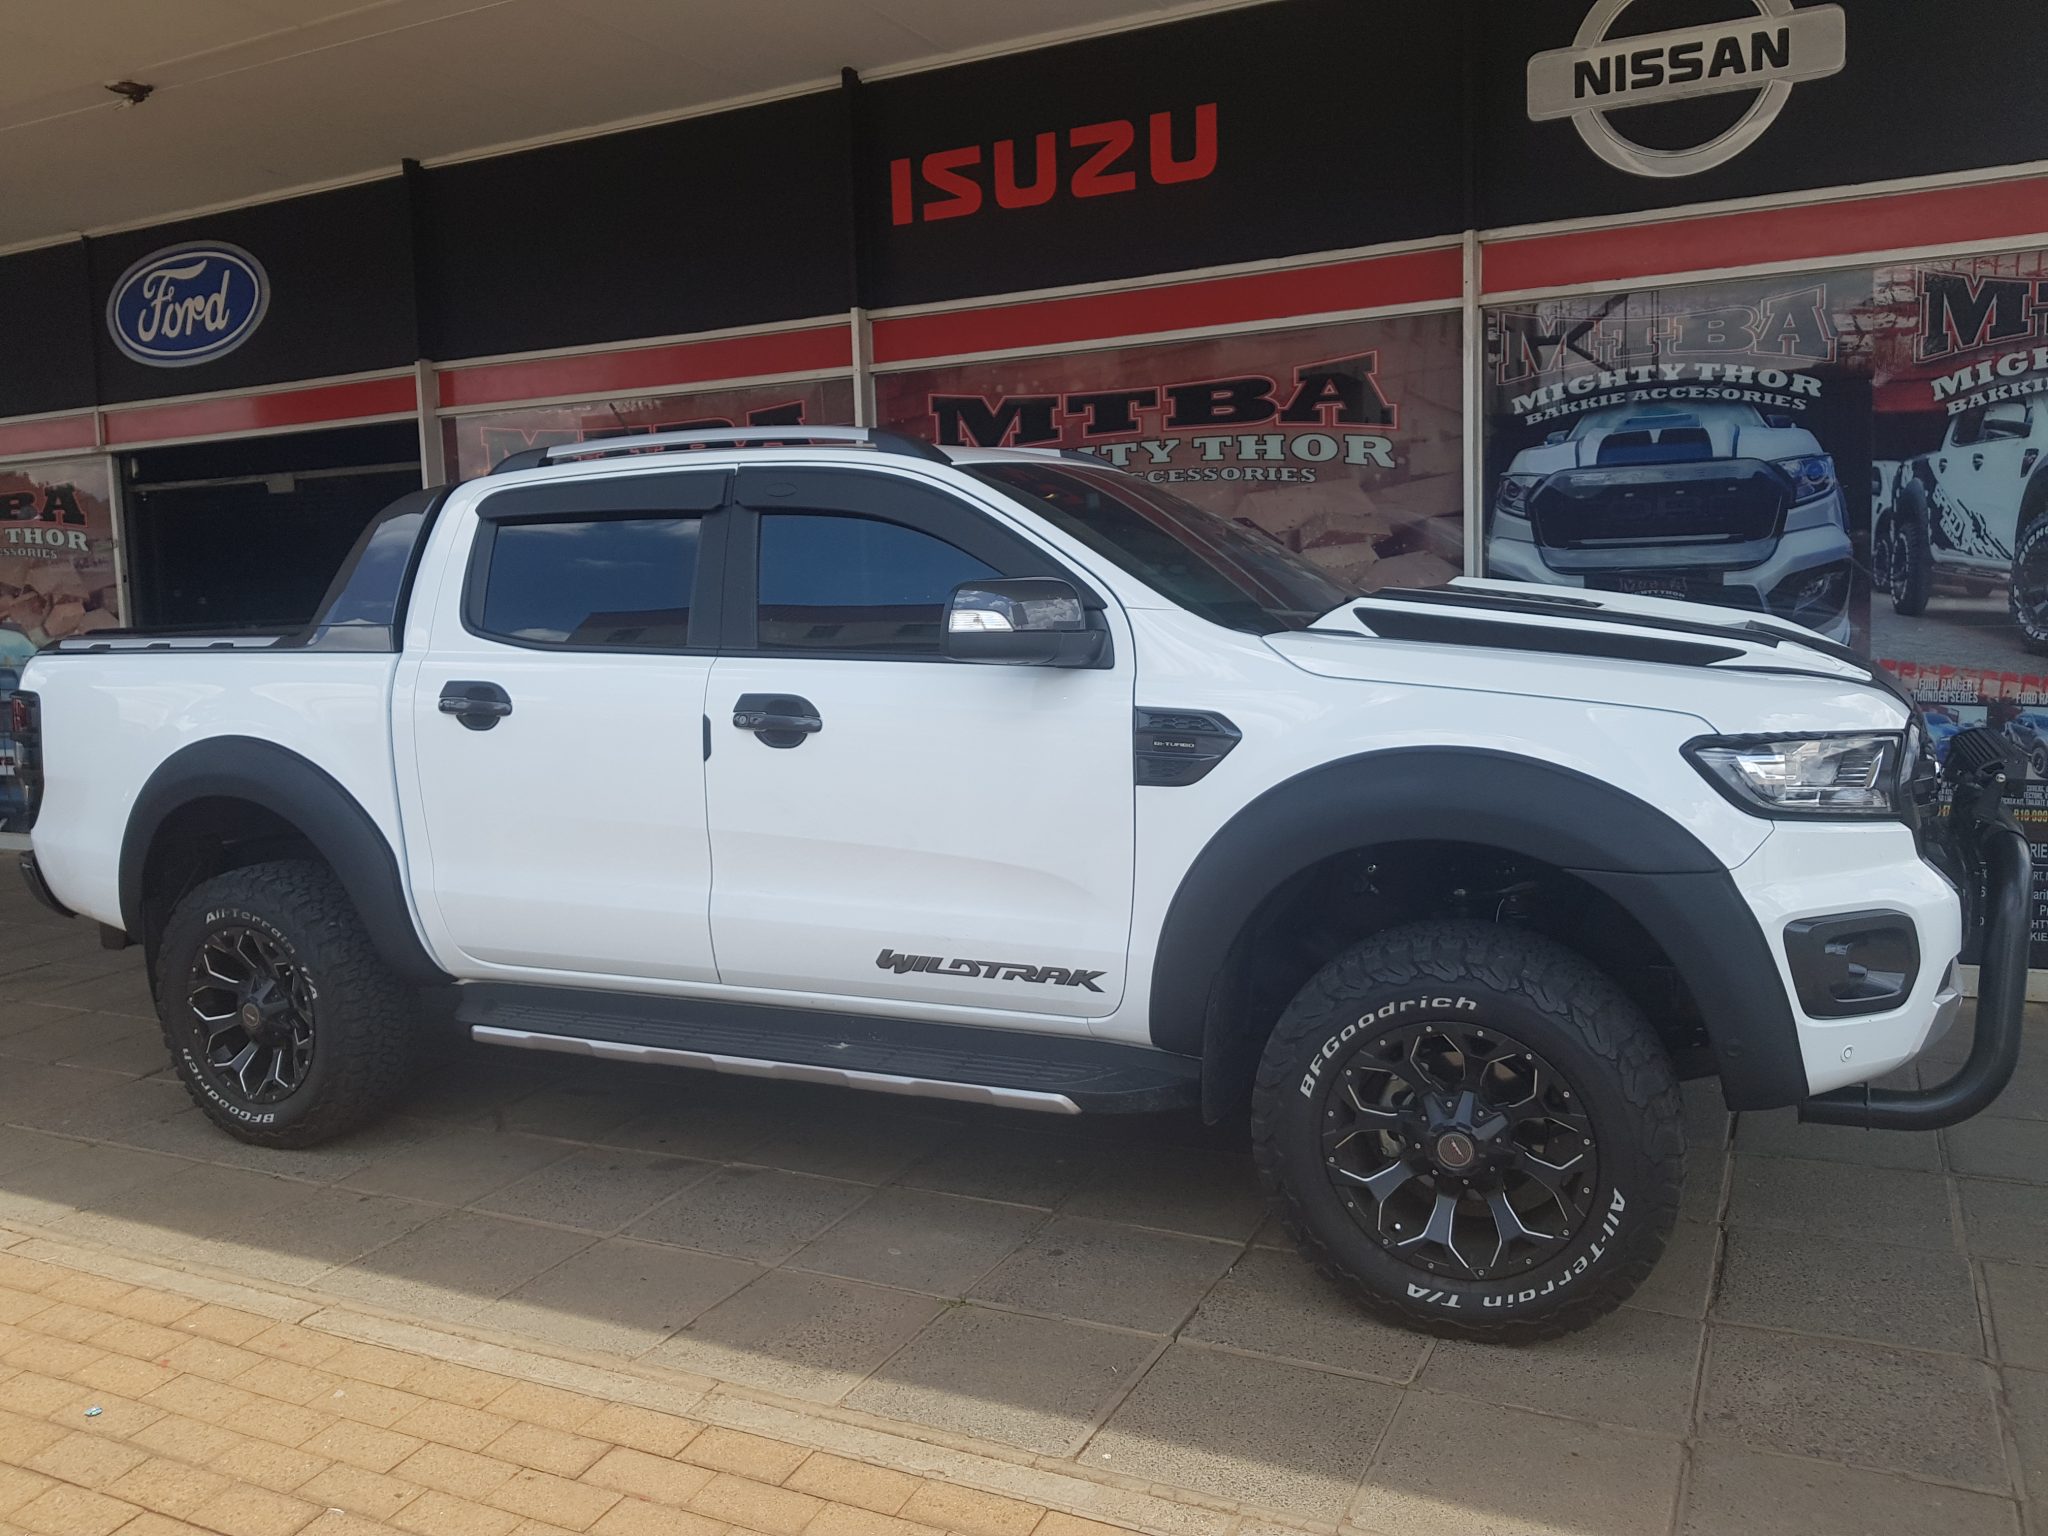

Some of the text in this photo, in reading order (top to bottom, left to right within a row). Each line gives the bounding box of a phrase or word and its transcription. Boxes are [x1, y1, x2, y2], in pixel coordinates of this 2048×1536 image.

[1574, 27, 1790, 99] NISSAN
[890, 102, 1218, 226] ISUZU
[138, 259, 230, 342] Ford
[1496, 284, 1837, 386] MTBA
[928, 350, 1398, 448] MTBA
[1511, 363, 1823, 416] MIGHTY THOR
[1526, 386, 1808, 426] BAKKIE ACCESORIES
[1193, 433, 1397, 469] THOR
[4, 528, 89, 552] THOR
[1913, 690, 1979, 703] THUNDER SERIES
[1919, 679, 1973, 692] FORD RANGER
[2016, 692, 2037, 704] FORD
[875, 948, 1108, 993] WILDTRAK
[1299, 995, 1478, 1098] BFGoodrich
[1406, 1187, 1626, 1309] All-Terrain T/A
